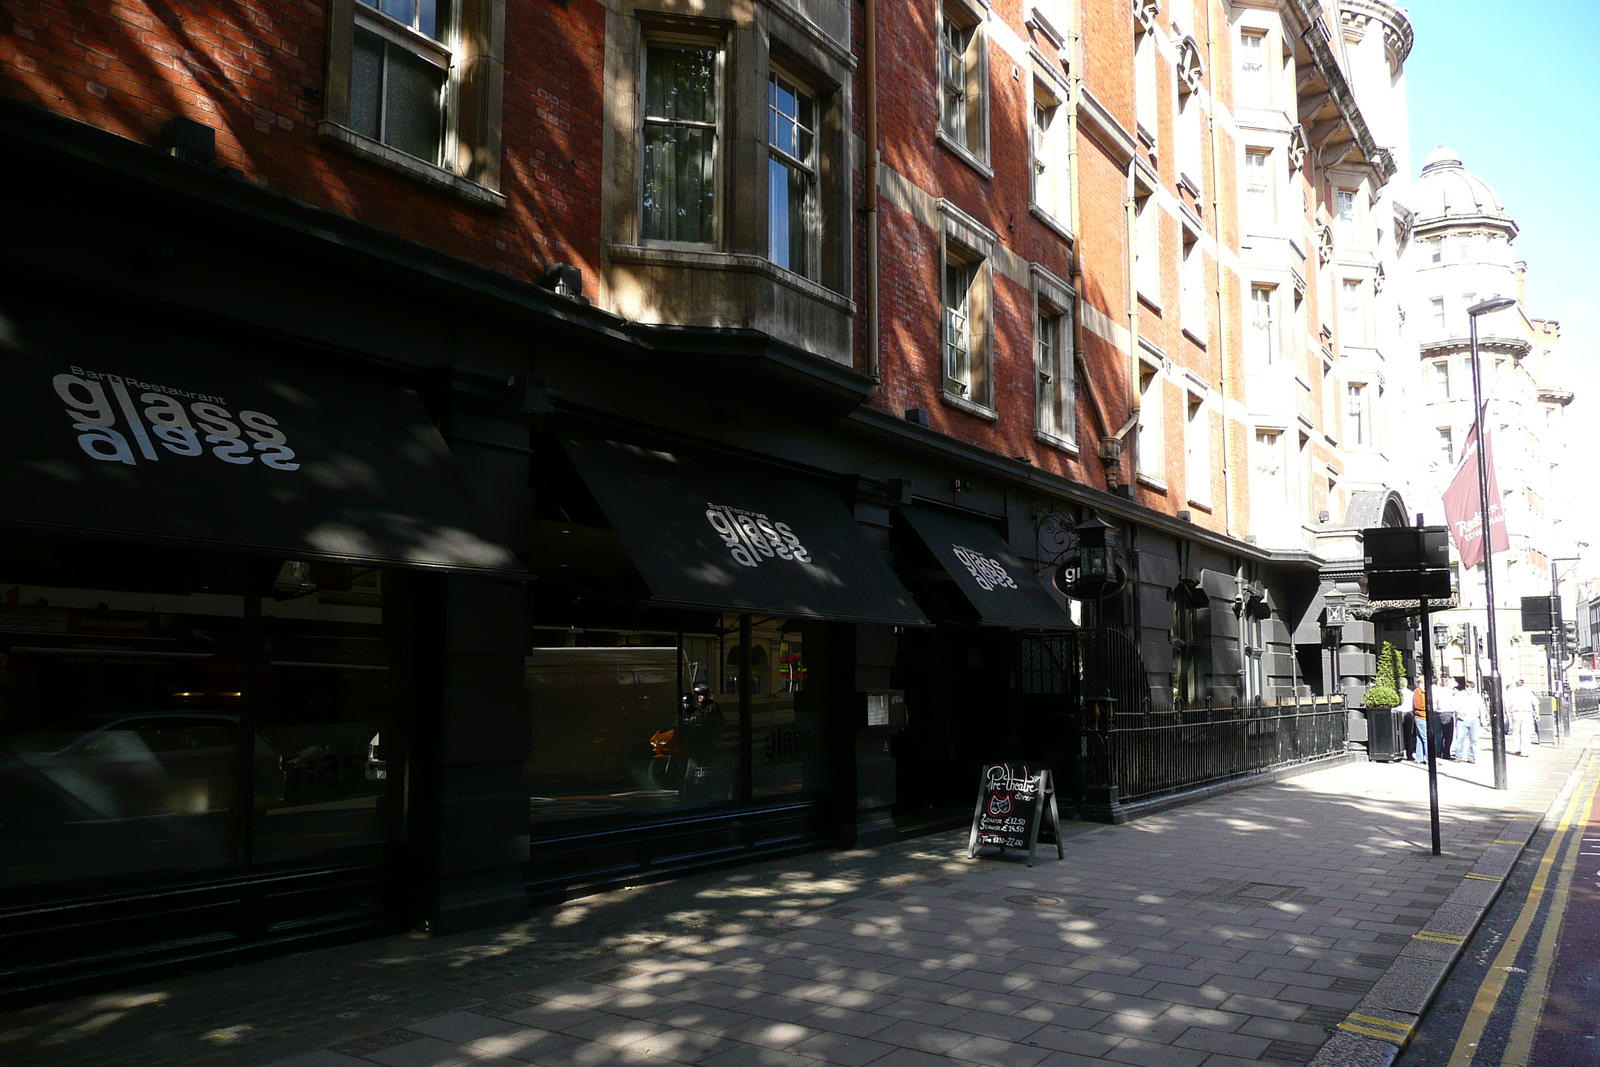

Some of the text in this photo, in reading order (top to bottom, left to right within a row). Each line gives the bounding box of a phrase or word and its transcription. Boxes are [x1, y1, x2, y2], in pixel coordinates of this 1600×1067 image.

[52, 373, 287, 446] glass
[125, 377, 227, 405] Restaurant
[705, 505, 800, 546] glass
